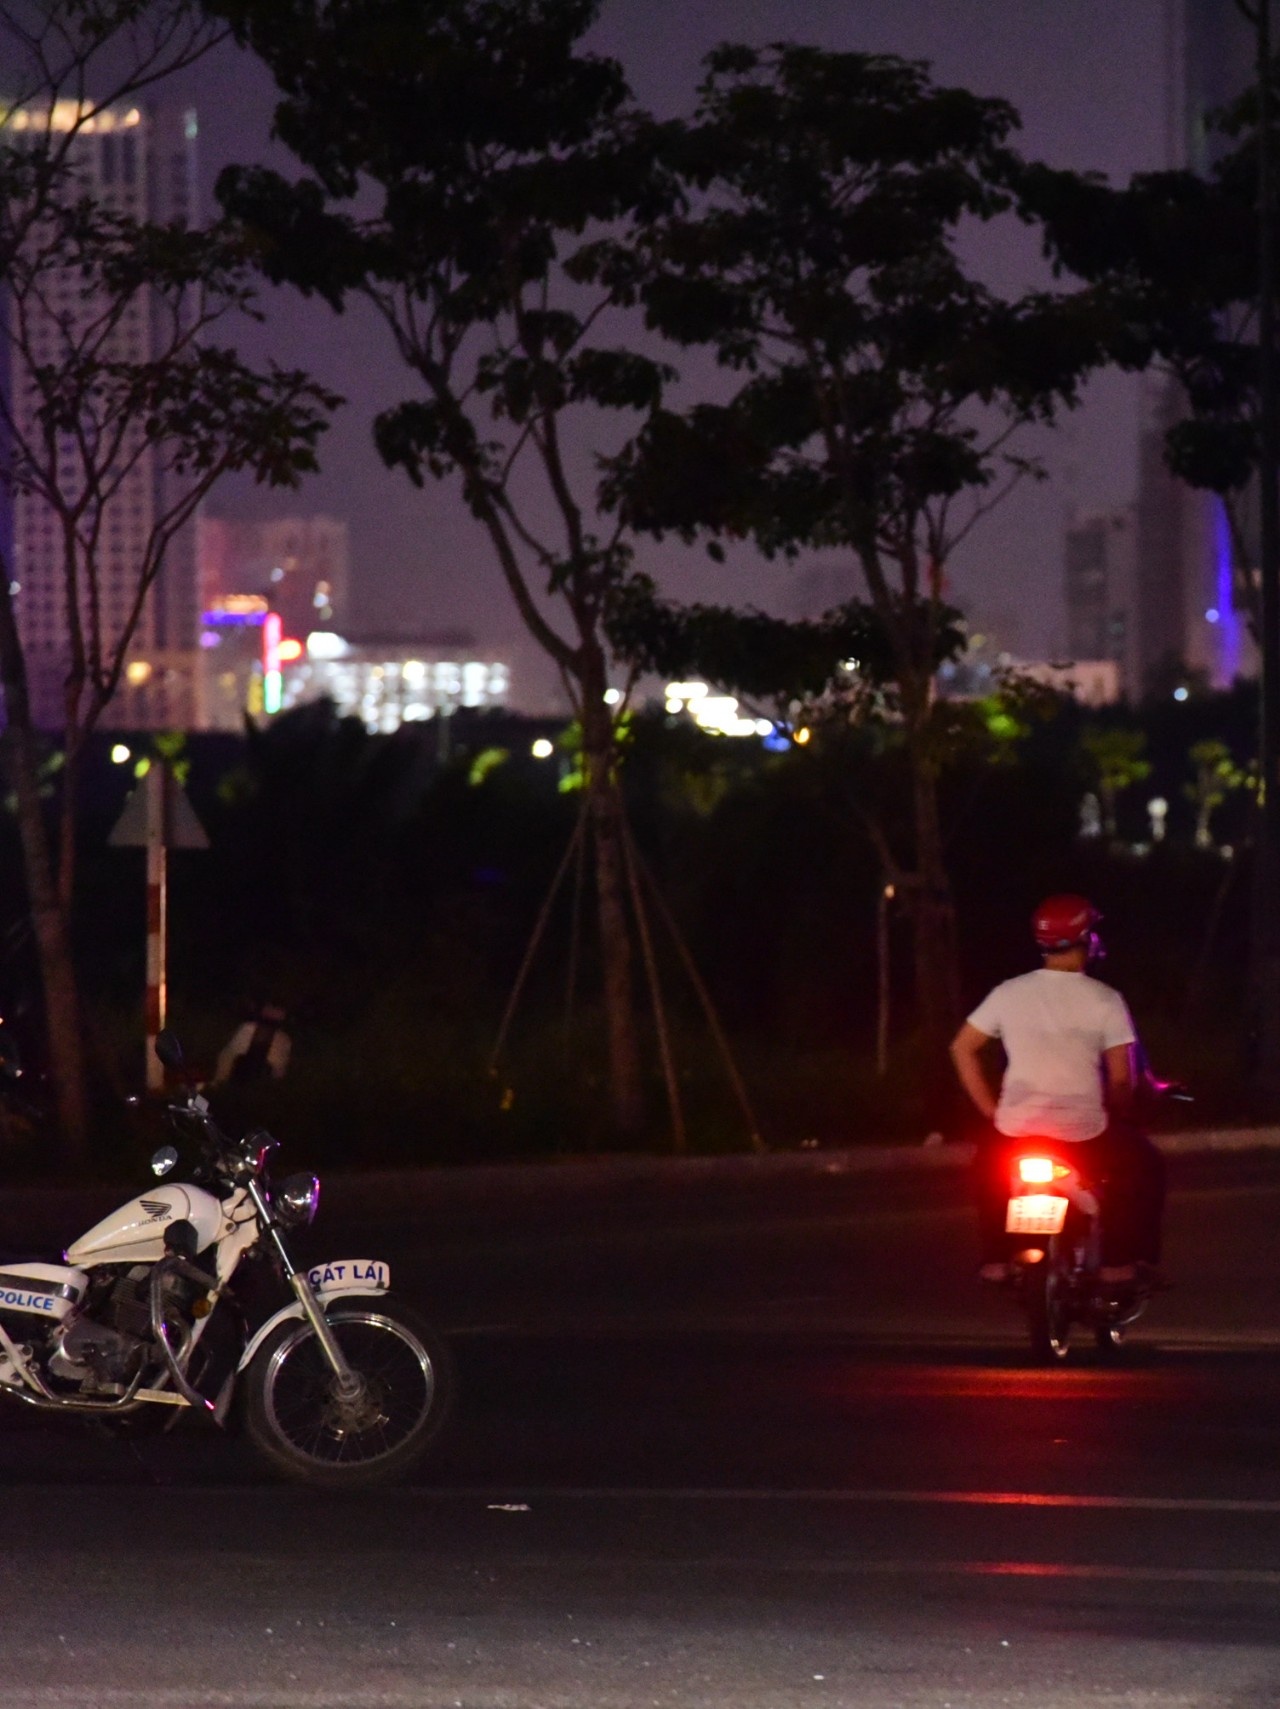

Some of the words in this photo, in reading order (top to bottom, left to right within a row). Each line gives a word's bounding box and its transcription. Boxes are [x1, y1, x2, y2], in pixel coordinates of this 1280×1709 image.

[138, 1215, 173, 1227] HONDA
[309, 1262, 346, 1285] CÁT
[353, 1260, 383, 1281] LÁI
